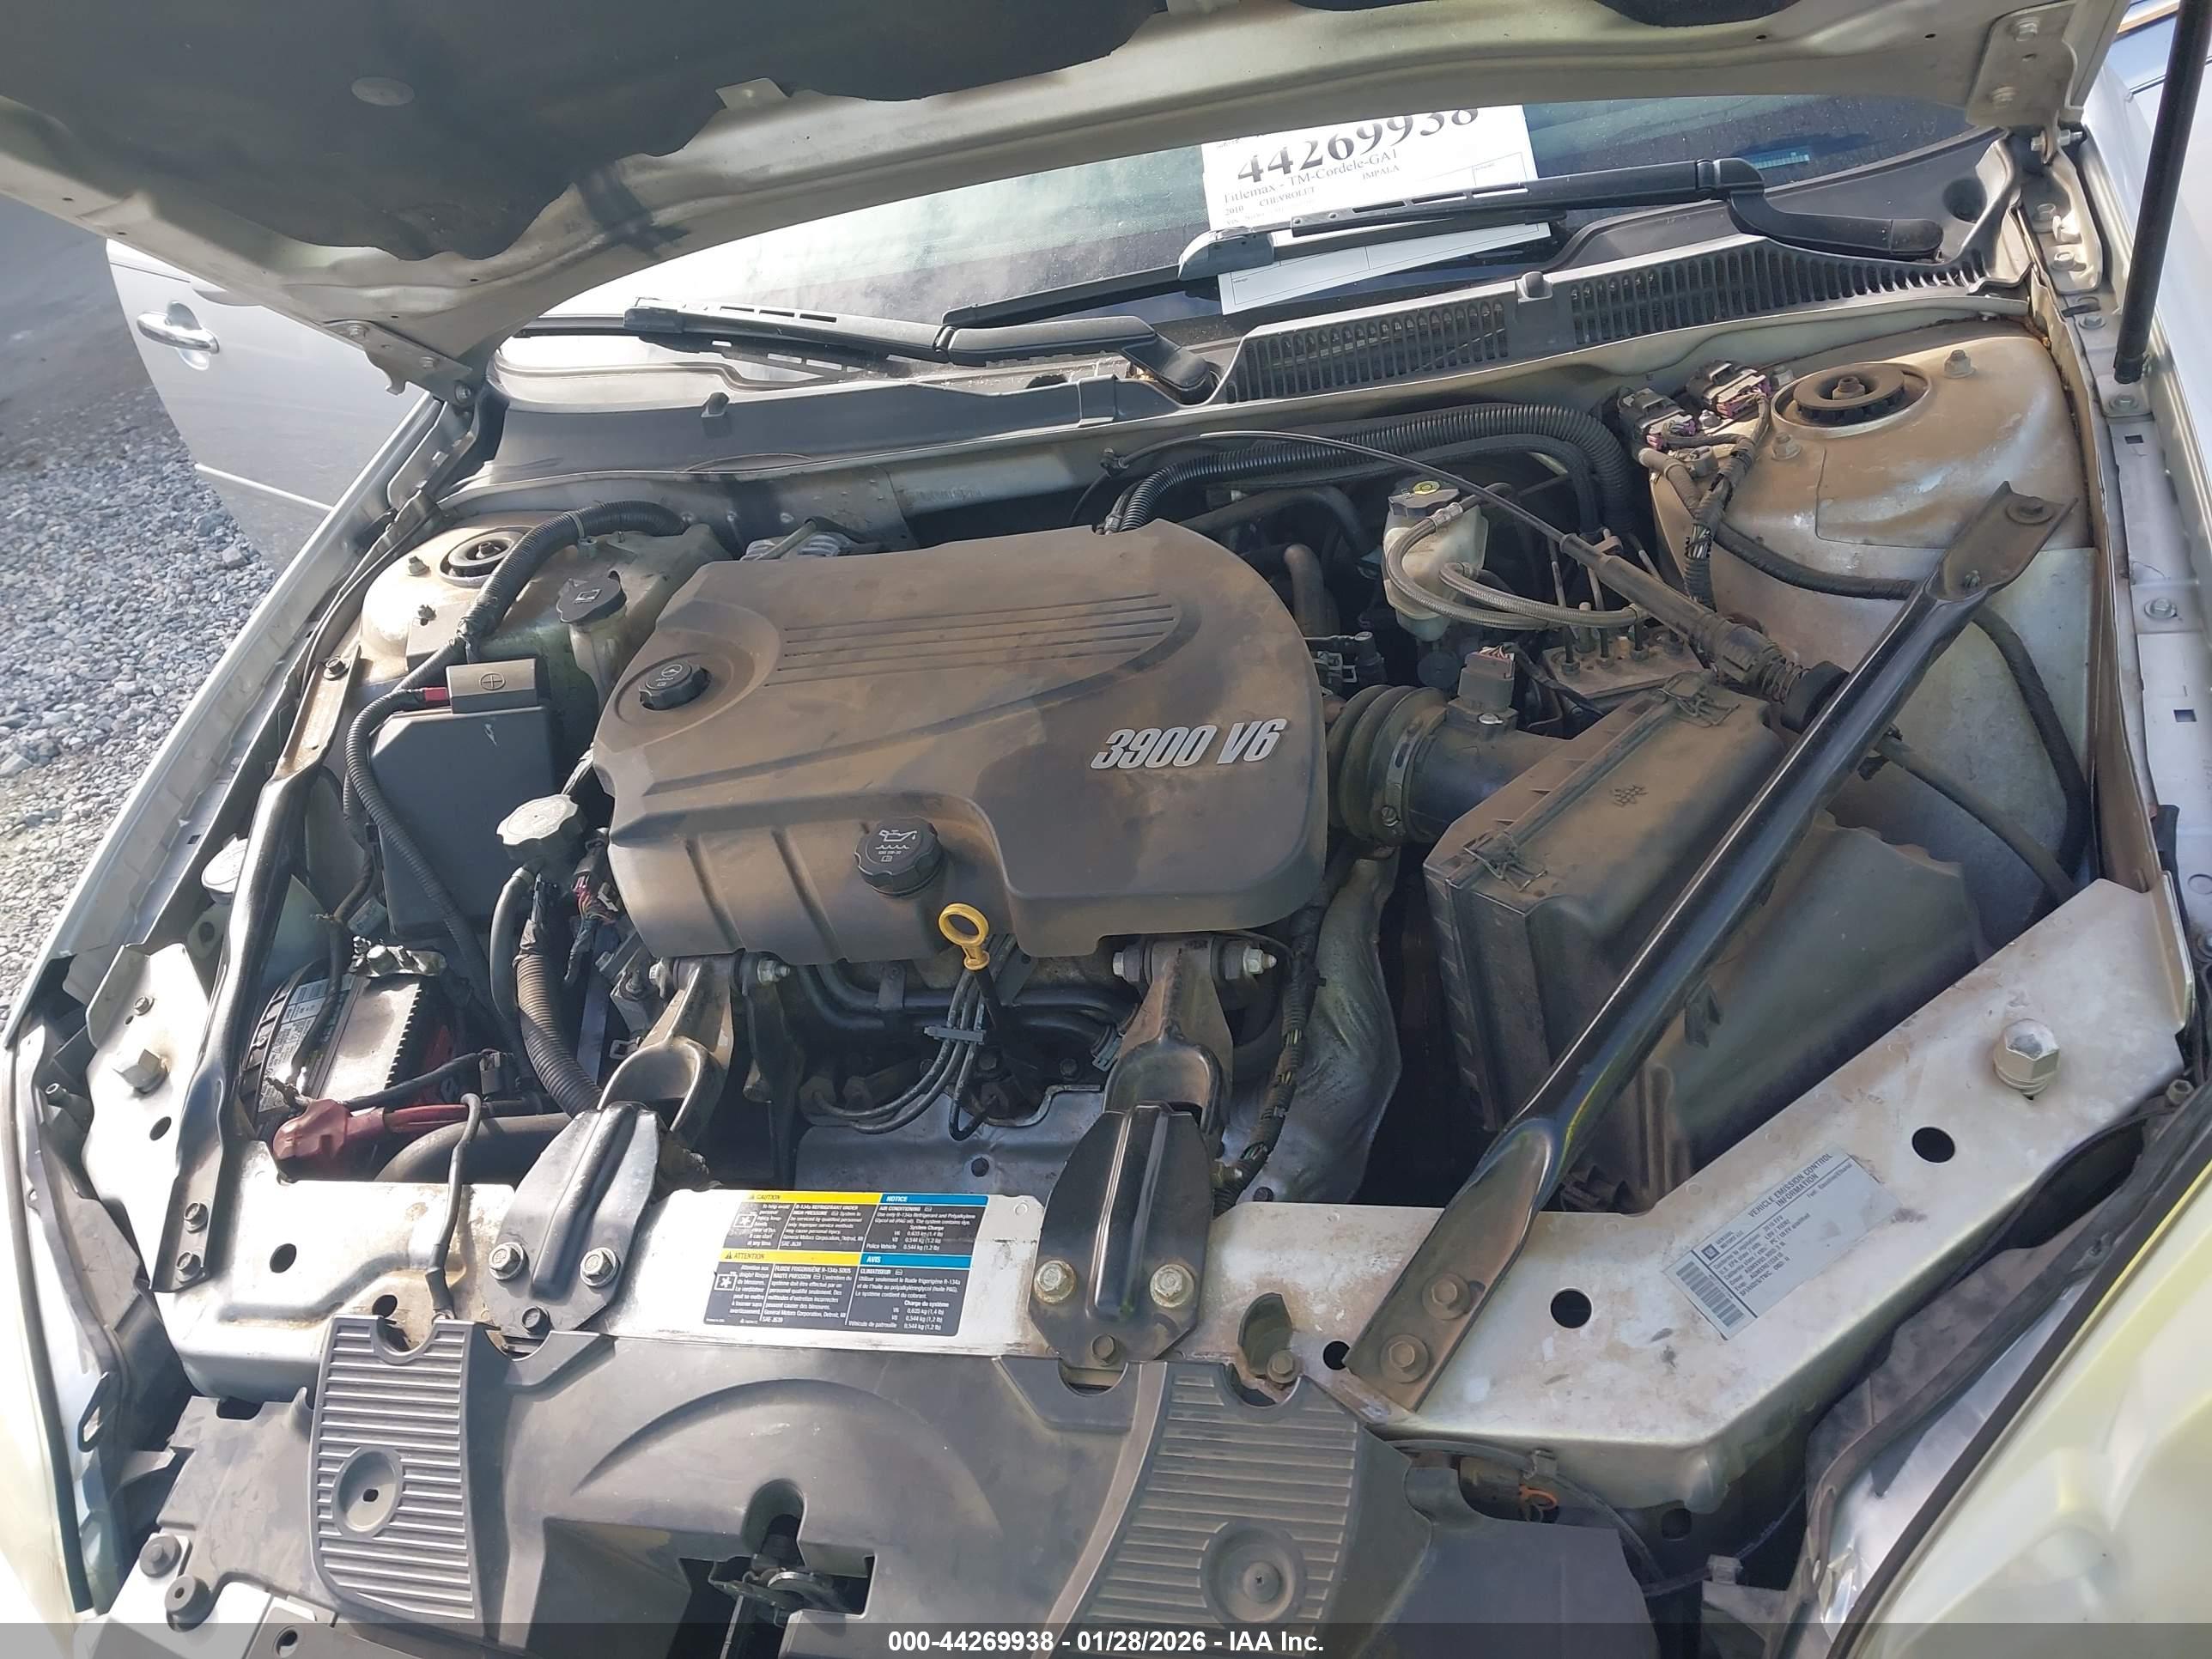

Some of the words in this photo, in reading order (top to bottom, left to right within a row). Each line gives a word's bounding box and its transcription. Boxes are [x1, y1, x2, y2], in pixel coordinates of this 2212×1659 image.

[1237, 108, 1479, 183] 44269938
[1224, 205, 1243, 216] 2010
[1363, 165, 1401, 180] IMPALA
[1091, 725, 1218, 769] 3900
[1216, 718, 1288, 765] V6
[1748, 1195, 1774, 1218] VEHICLE
[1773, 1173, 1804, 1199] EMISSION
[1802, 1152, 1832, 1176] CONTROL
[1775, 1173, 1820, 1207] INFORMATION
